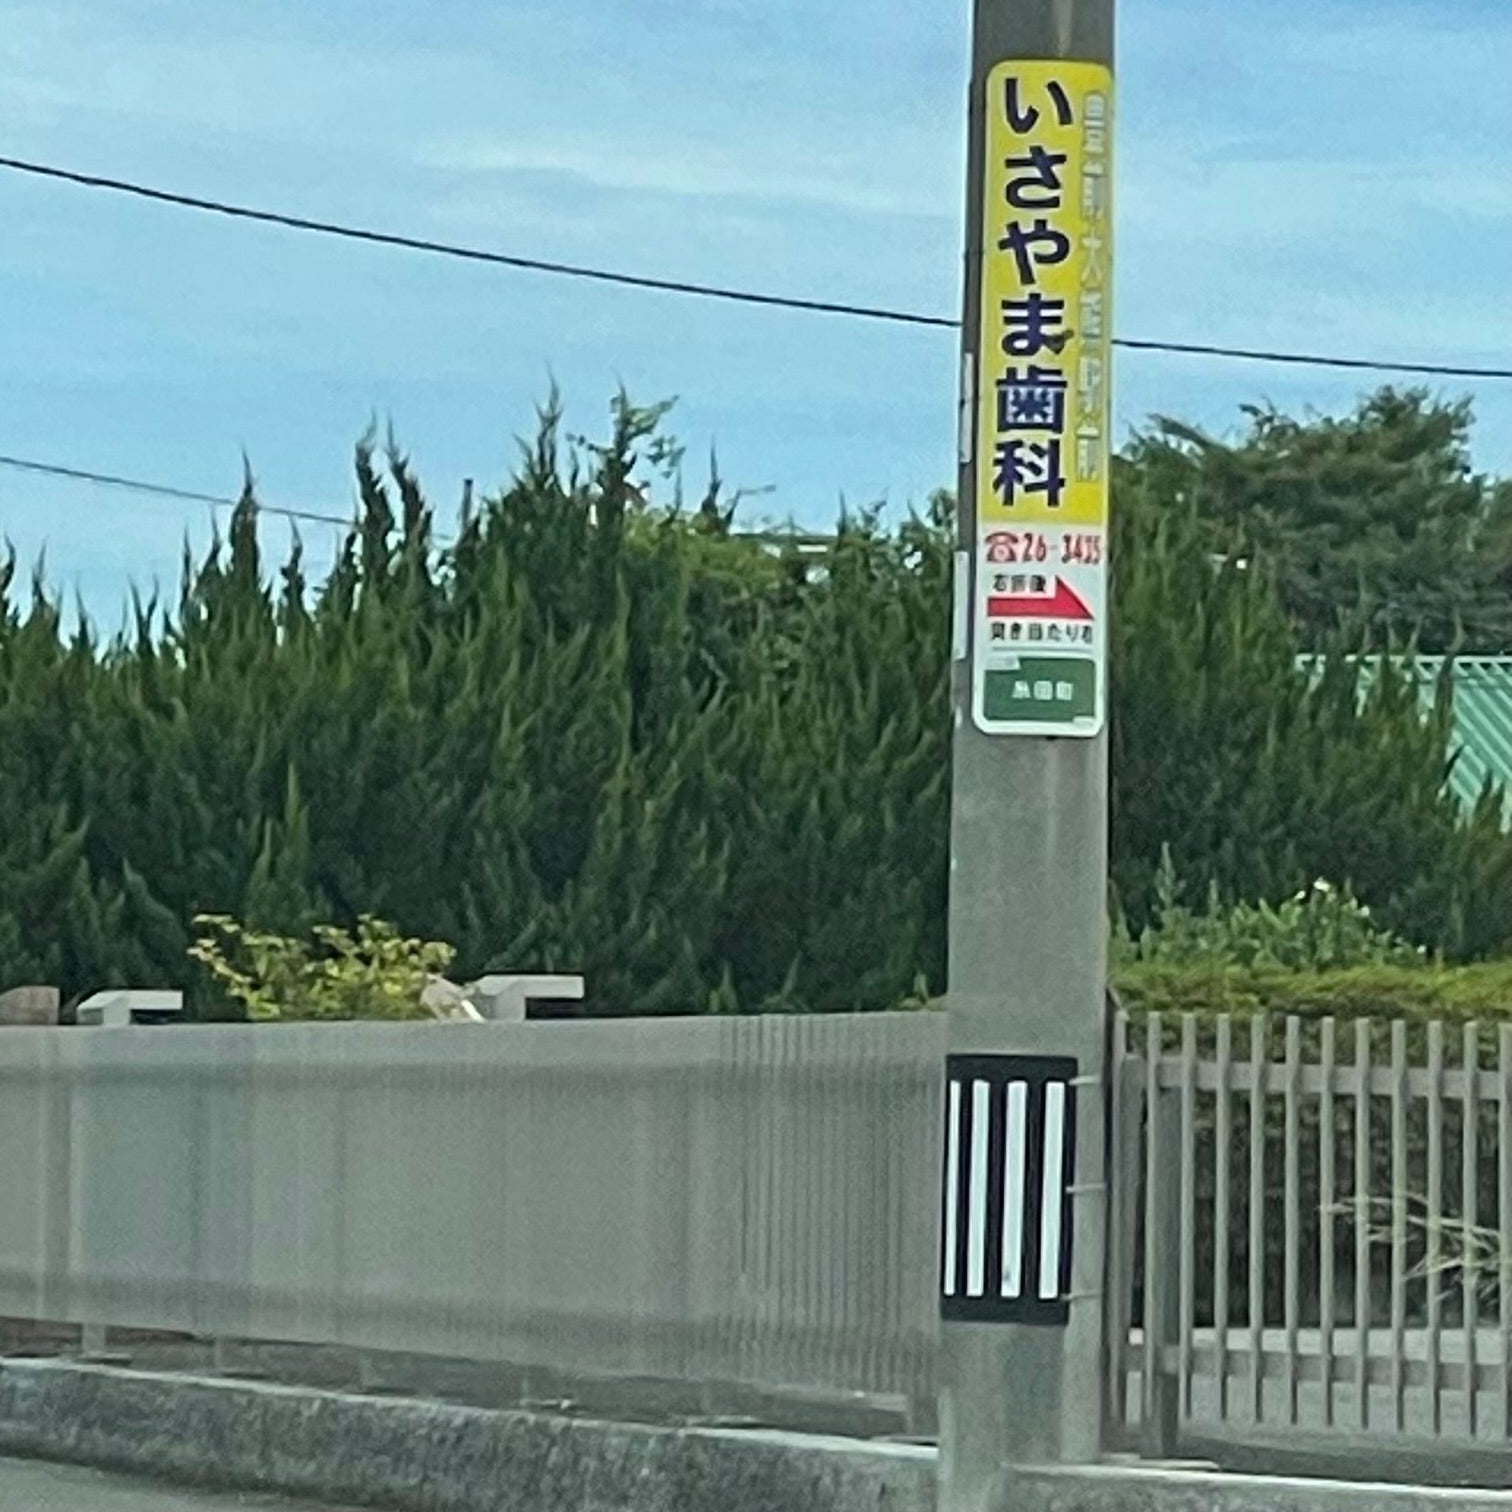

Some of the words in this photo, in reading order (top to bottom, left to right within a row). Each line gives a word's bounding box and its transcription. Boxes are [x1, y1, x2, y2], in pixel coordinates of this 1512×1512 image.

[991, 77, 1074, 507] いさやま歯科
